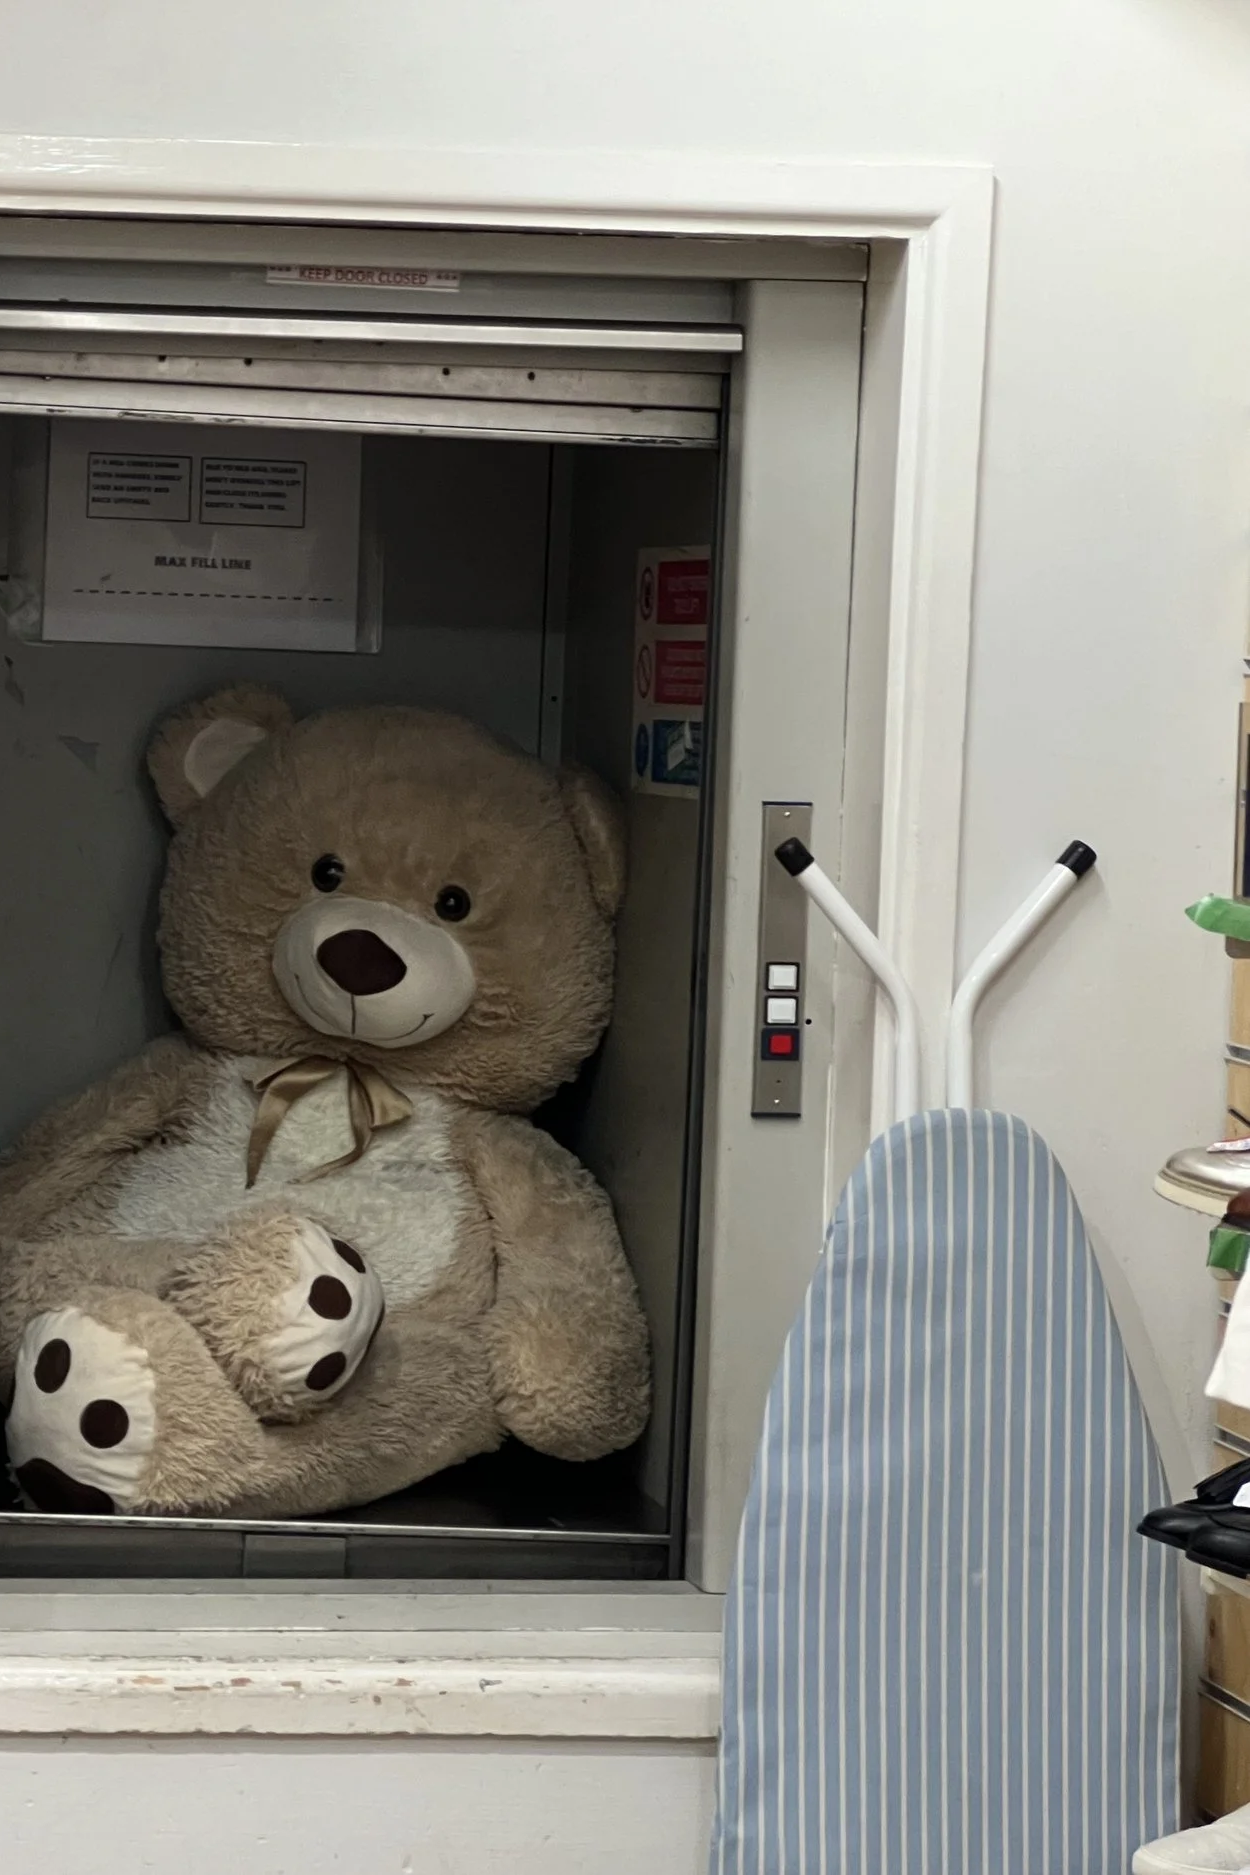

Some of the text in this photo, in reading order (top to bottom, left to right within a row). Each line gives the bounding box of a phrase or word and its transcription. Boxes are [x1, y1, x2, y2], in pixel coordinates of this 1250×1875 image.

[299, 267, 429, 286] KEEP DOOR CLOSED
[154, 556, 252, 570] MAX FILL LINE
